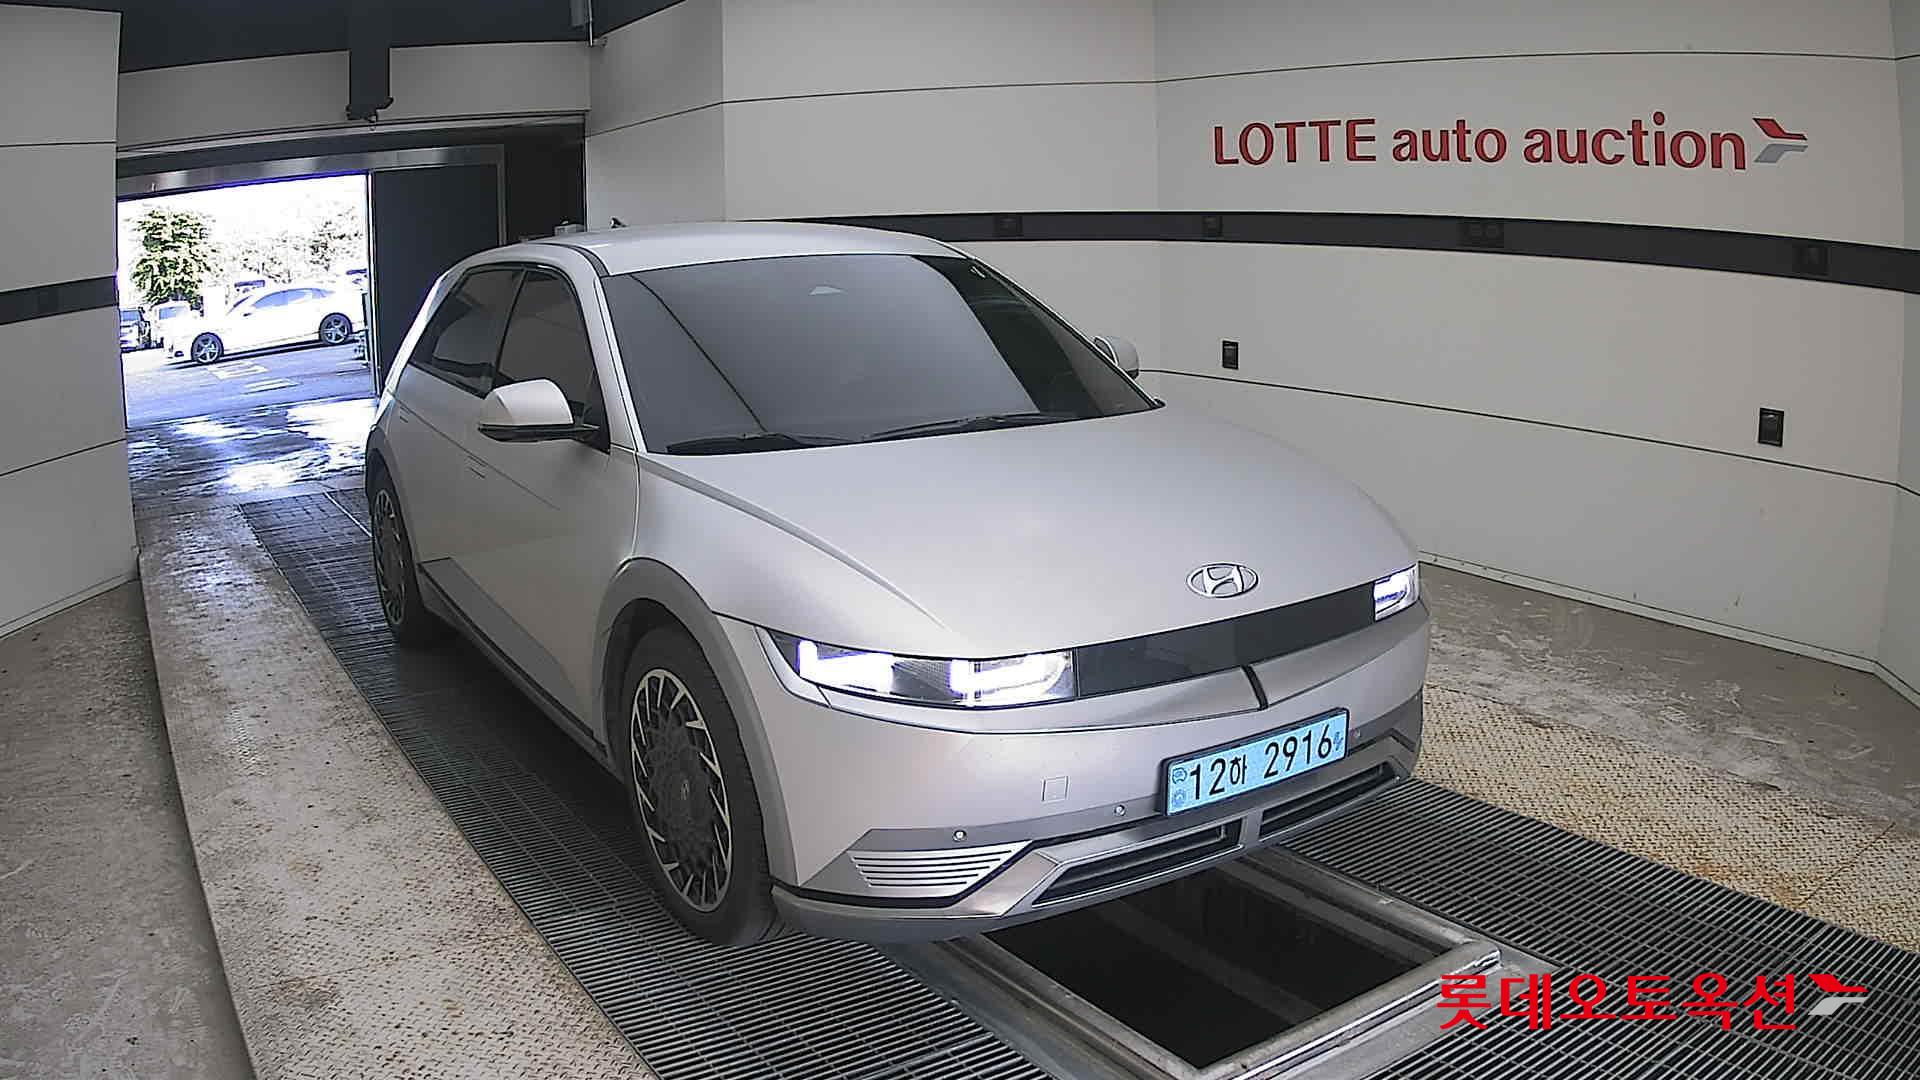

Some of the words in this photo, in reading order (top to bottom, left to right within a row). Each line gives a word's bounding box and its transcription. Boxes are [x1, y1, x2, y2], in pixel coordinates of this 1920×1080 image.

[1214, 118, 1377, 166] LOTTE
[1392, 119, 1508, 164] auto
[1523, 111, 1747, 170] auction
[1190, 754, 1248, 800] 12하
[1263, 724, 1333, 779] 2916
